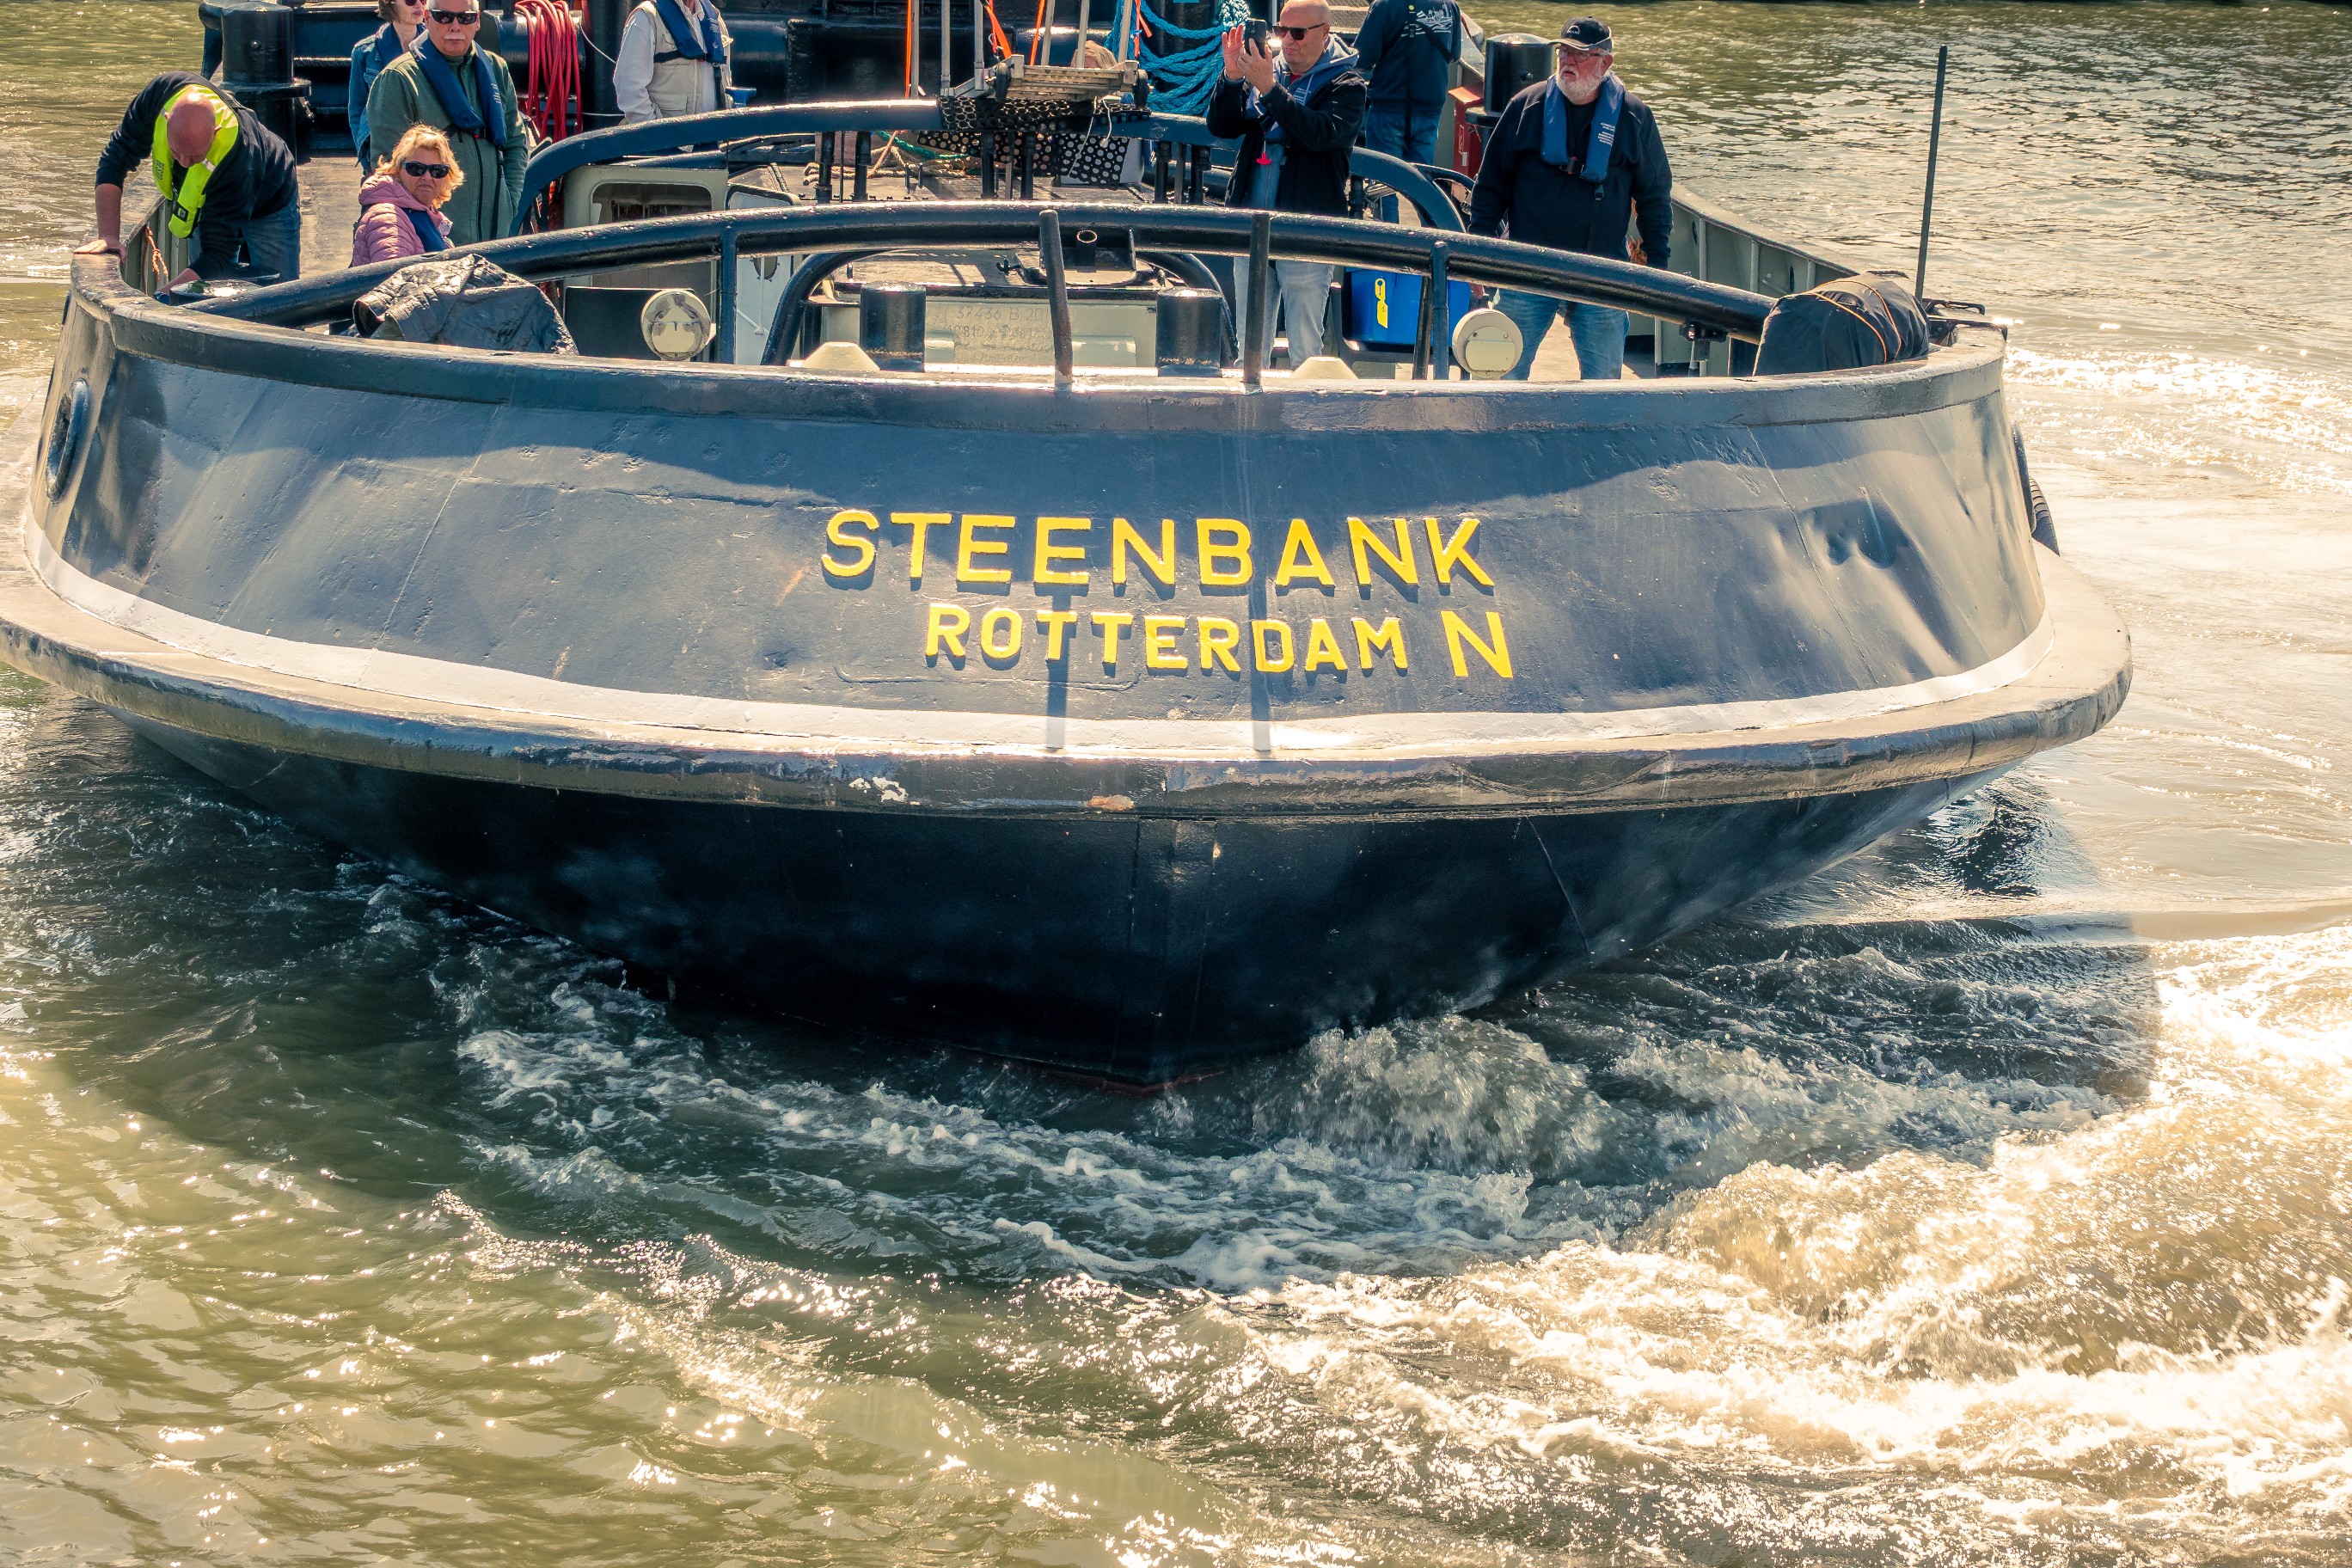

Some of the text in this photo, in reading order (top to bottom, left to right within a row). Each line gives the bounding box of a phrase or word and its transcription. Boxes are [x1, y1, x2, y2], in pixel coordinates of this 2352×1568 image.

[822, 509, 1495, 587] STEENBANK
[924, 603, 1514, 680] ROTTERDAM N
